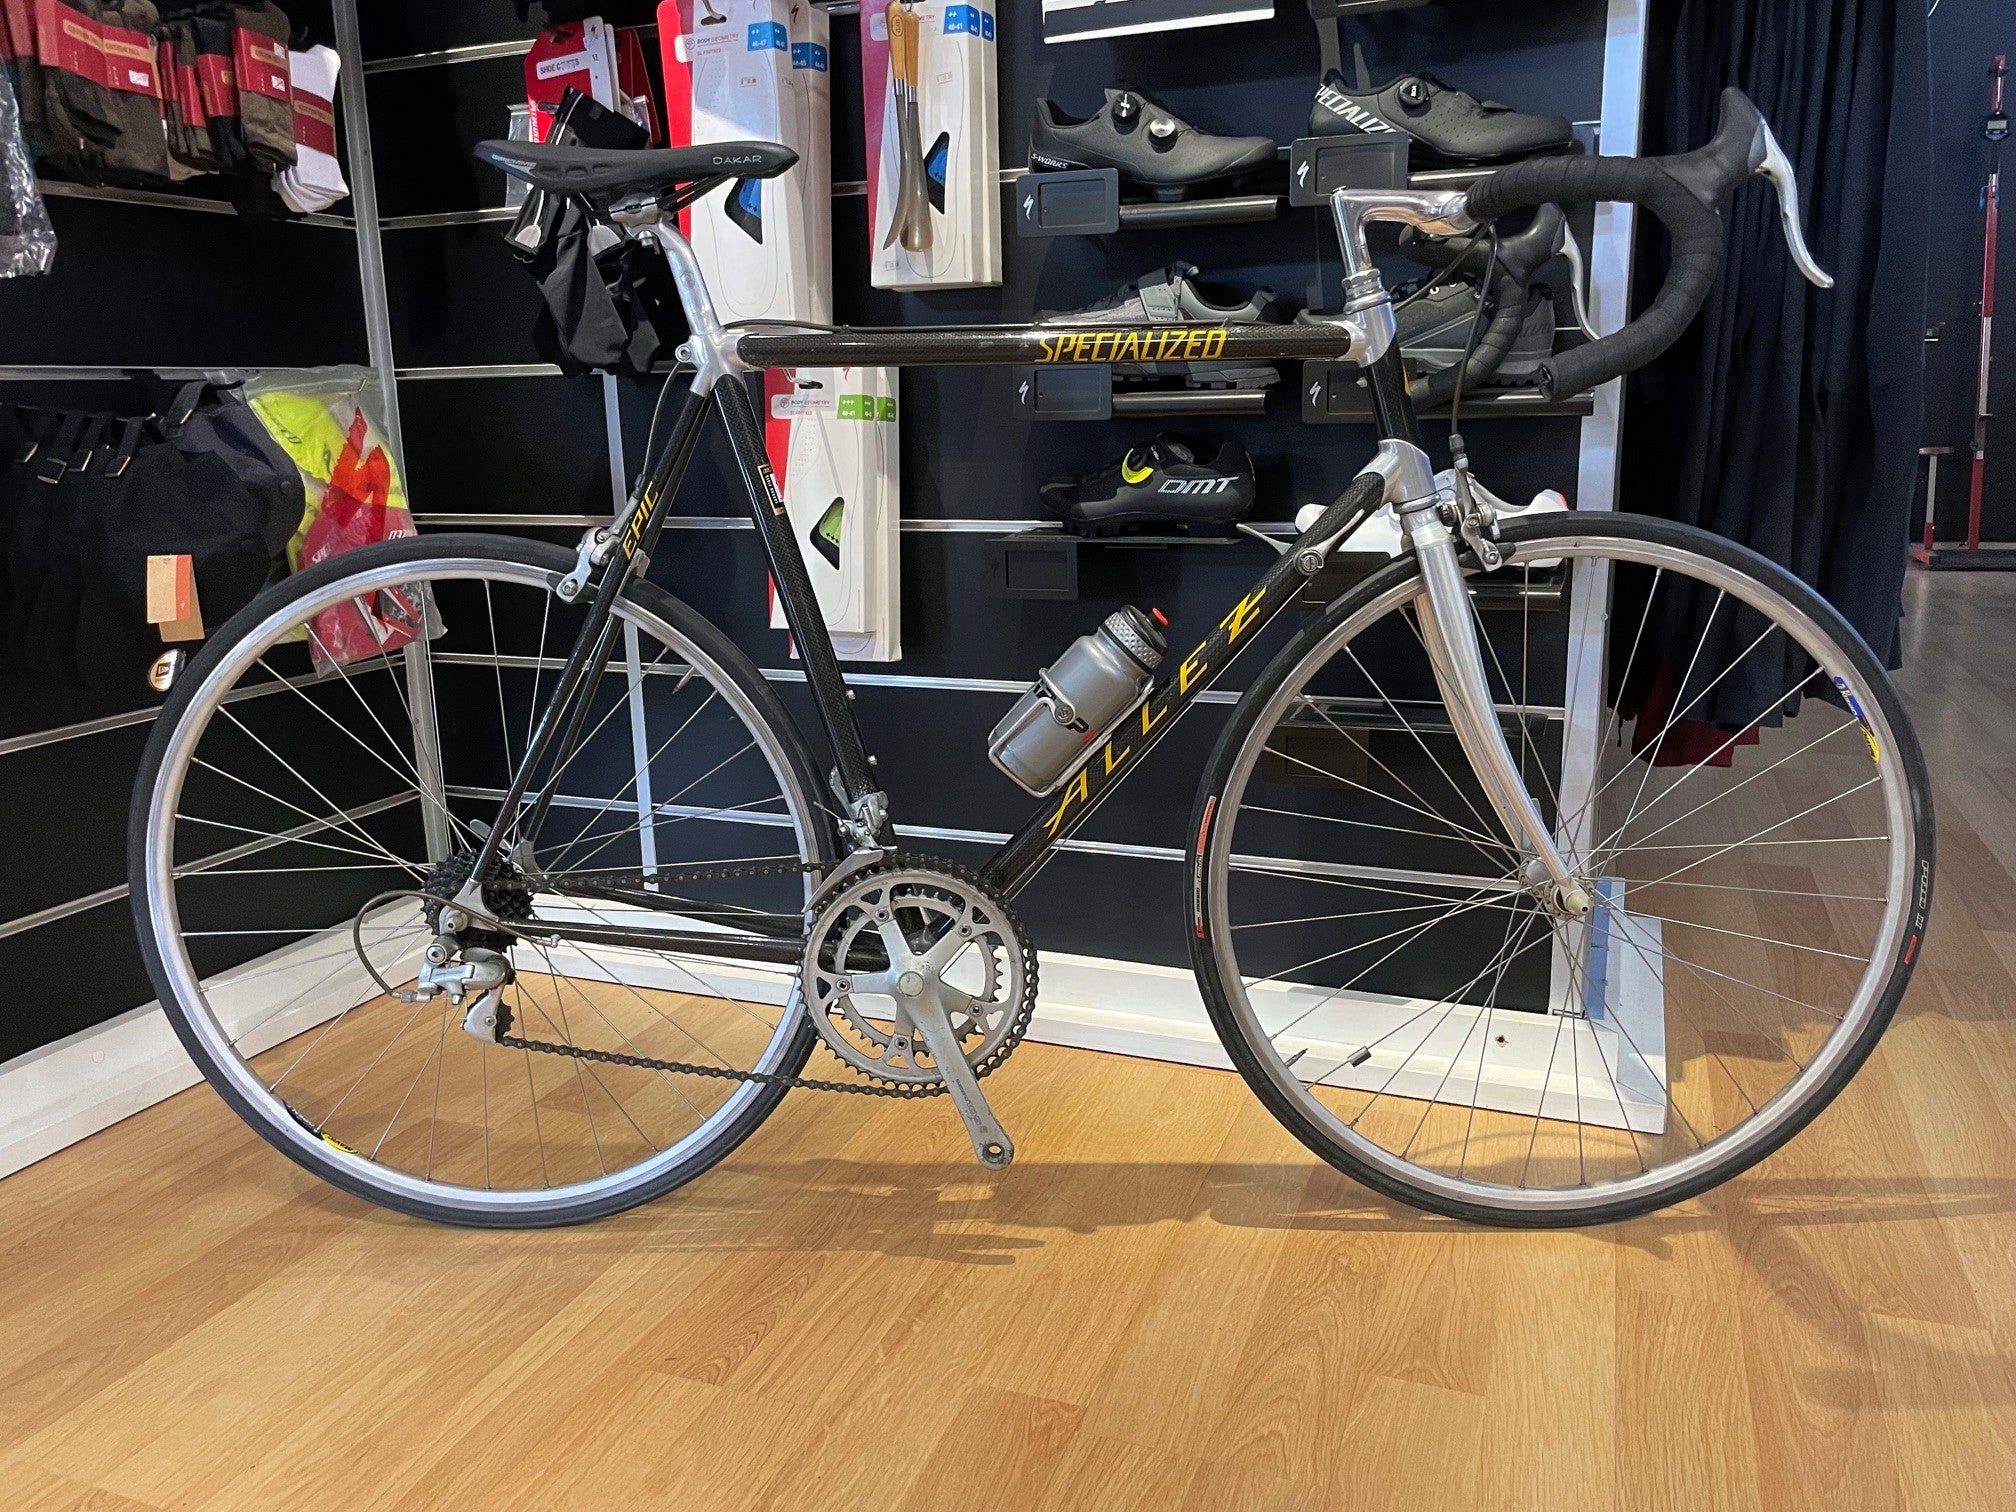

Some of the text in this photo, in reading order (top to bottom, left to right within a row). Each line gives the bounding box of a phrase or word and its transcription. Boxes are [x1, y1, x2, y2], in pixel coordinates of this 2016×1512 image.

[540, 64, 556, 74] SHOE
[712, 154, 763, 165] DAKAR
[1031, 153, 1069, 169] S-WORKS
[1034, 329, 1228, 363] SPECIALIZED
[1157, 476, 1239, 494] DMT
[622, 480, 659, 560] EPIC
[1043, 586, 1267, 839] ALLEZ
